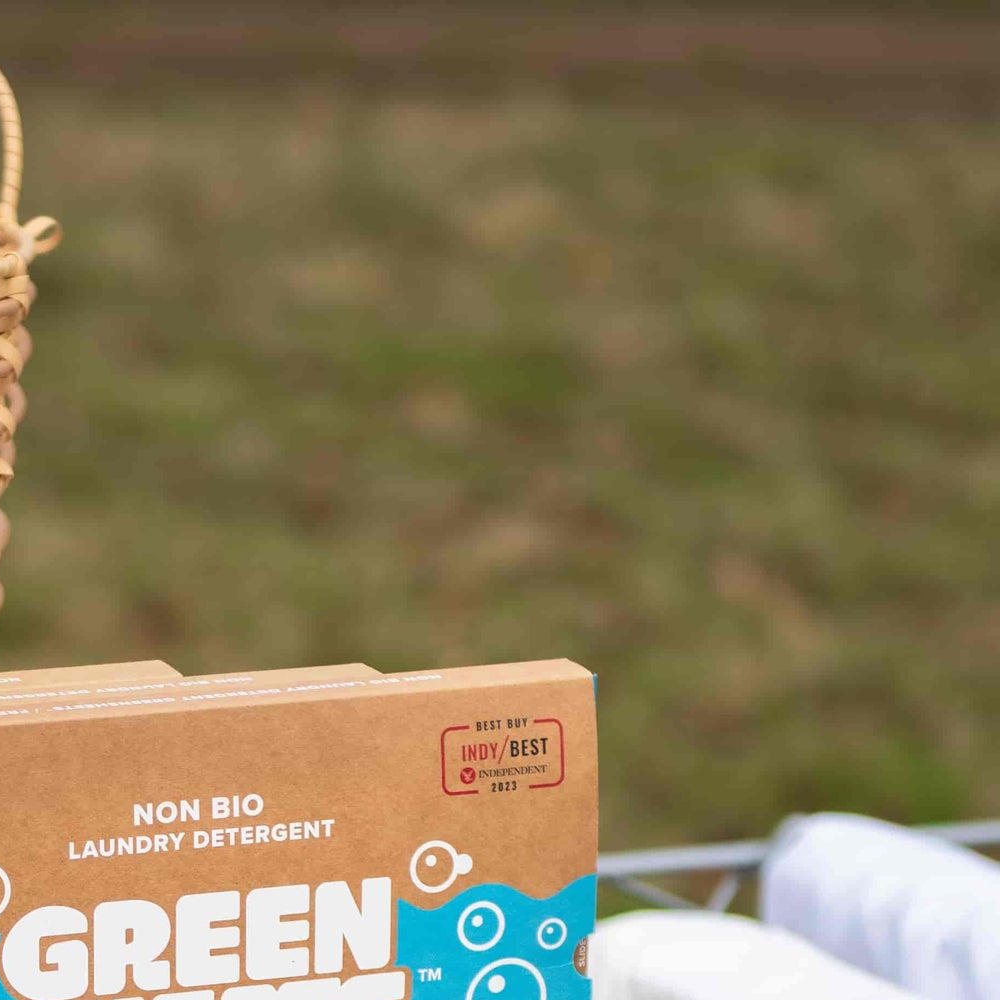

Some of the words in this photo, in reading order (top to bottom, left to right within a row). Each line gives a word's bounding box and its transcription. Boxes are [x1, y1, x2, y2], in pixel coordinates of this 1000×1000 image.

[476, 720, 502, 732] BEST
[507, 717, 528, 729] BUY
[478, 764, 549, 779] INDEPENDENT
[491, 780, 518, 793] 2023
[133, 798, 200, 826] NON
[211, 793, 264, 820] BIO
[68, 832, 185, 860] LAUNDRY
[193, 819, 335, 849] DETERGENT
